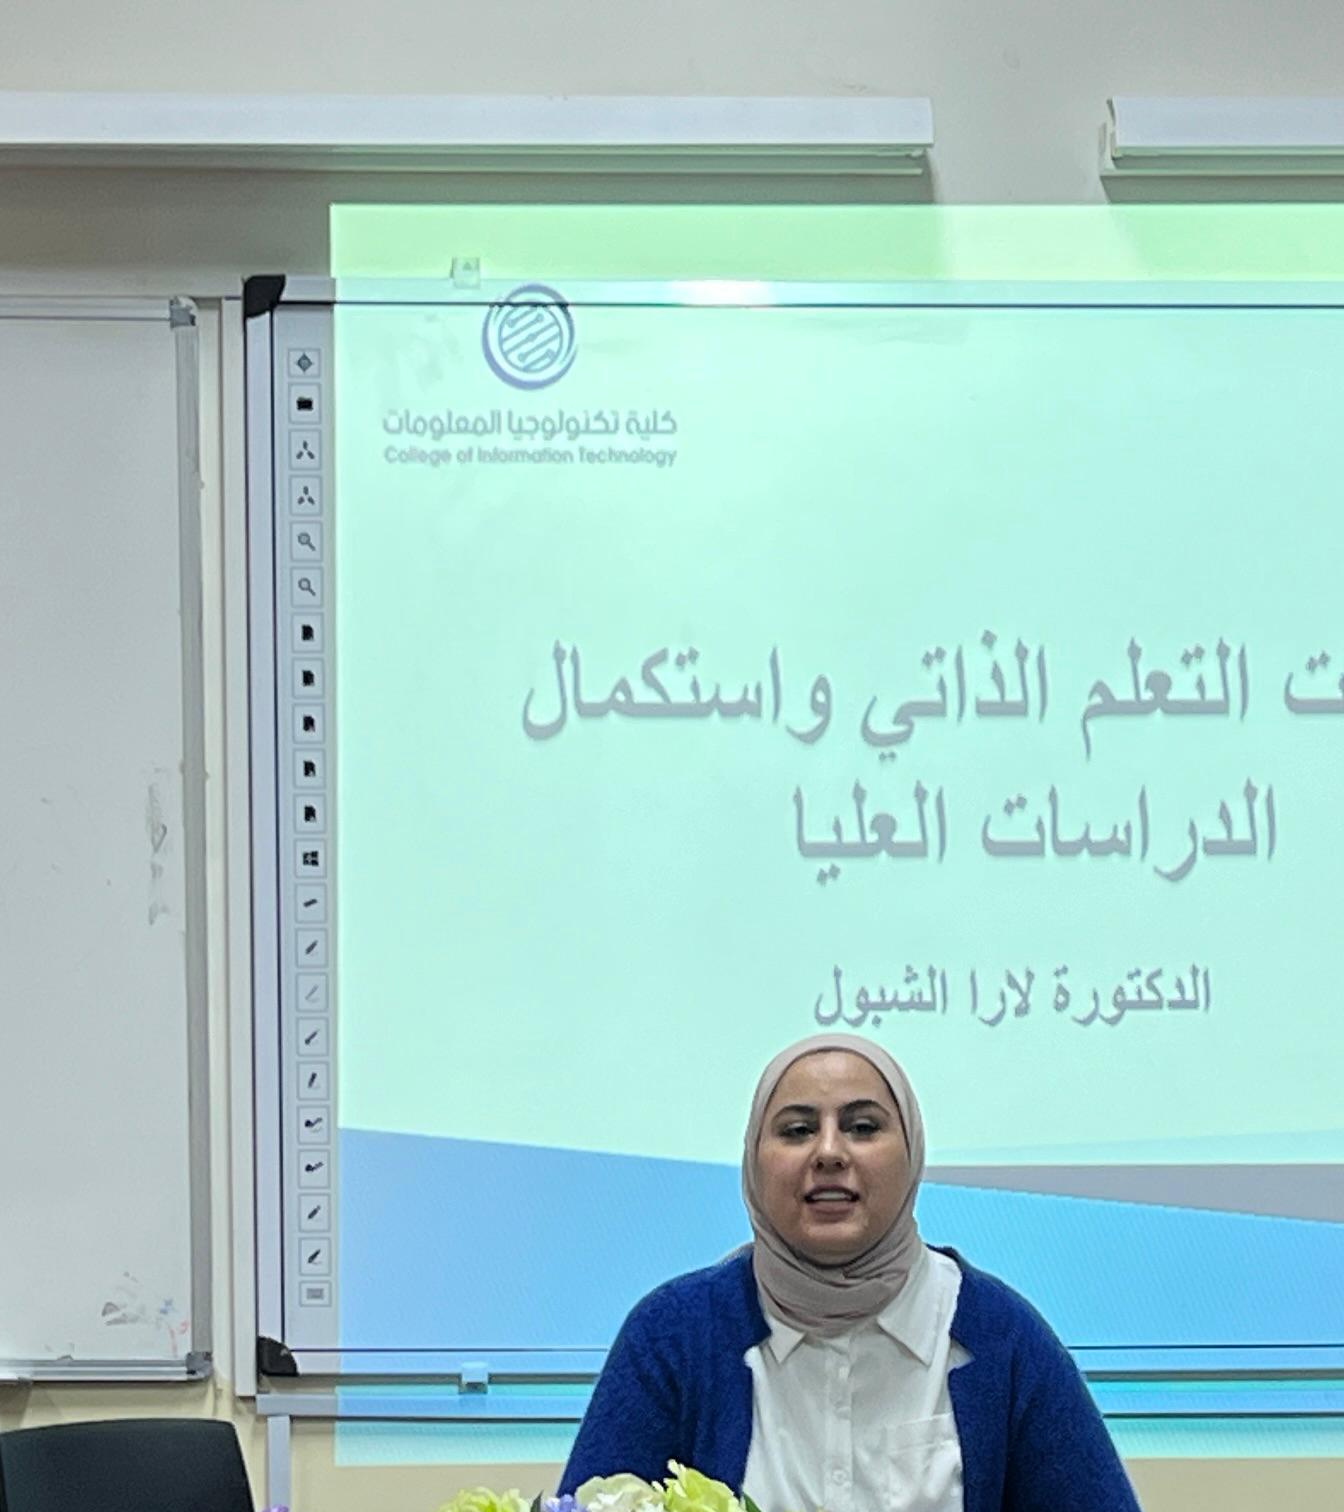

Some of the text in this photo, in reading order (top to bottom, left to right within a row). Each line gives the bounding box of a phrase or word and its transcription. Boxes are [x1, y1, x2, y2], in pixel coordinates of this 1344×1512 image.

[382, 408, 678, 441] كلية تكنولوجيا المعلومات
[383, 445, 678, 468] College of Information Technology
[522, 638, 833, 746] واستكمال
[860, 629, 1049, 763] الذاتي
[1080, 636, 1250, 762] التعلم
[792, 777, 1277, 886] الدراسات العليا
[813, 963, 1212, 1029] الدكتورة لارا الشبول
